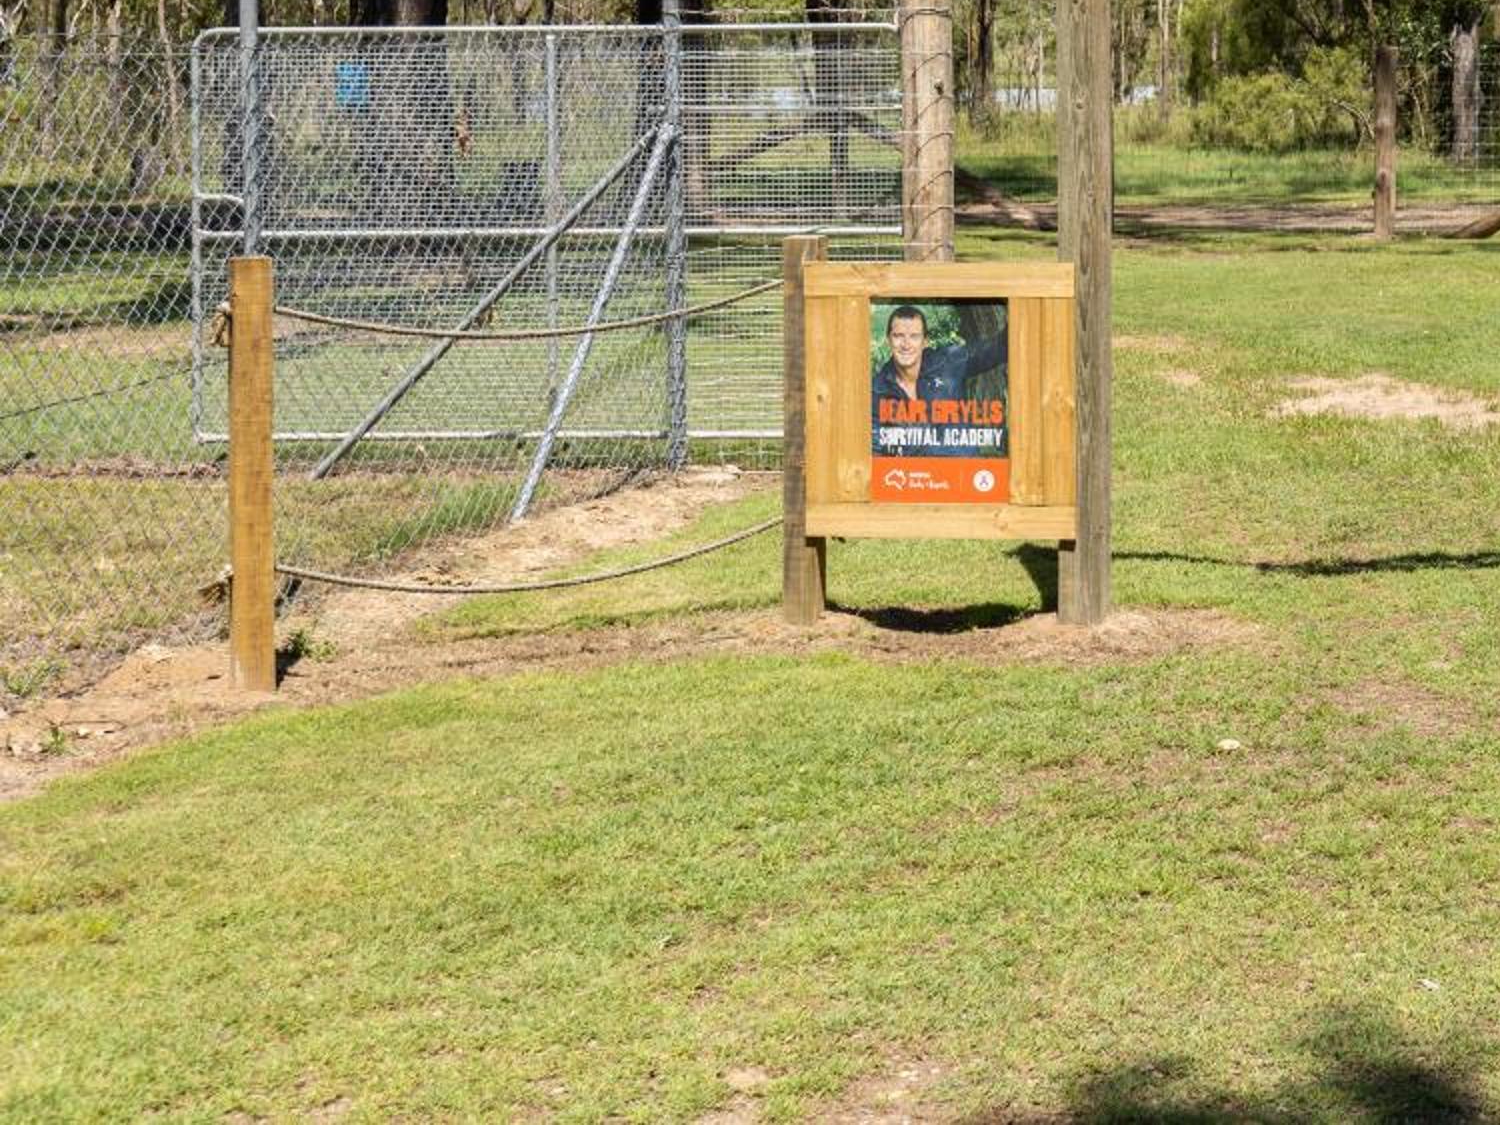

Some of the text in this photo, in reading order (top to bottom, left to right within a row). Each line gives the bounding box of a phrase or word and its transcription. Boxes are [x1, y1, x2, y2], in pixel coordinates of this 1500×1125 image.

[879, 397, 1004, 425] BEAR GRYLLS
[879, 426, 1003, 447] SURVIVAL ACADEMY
